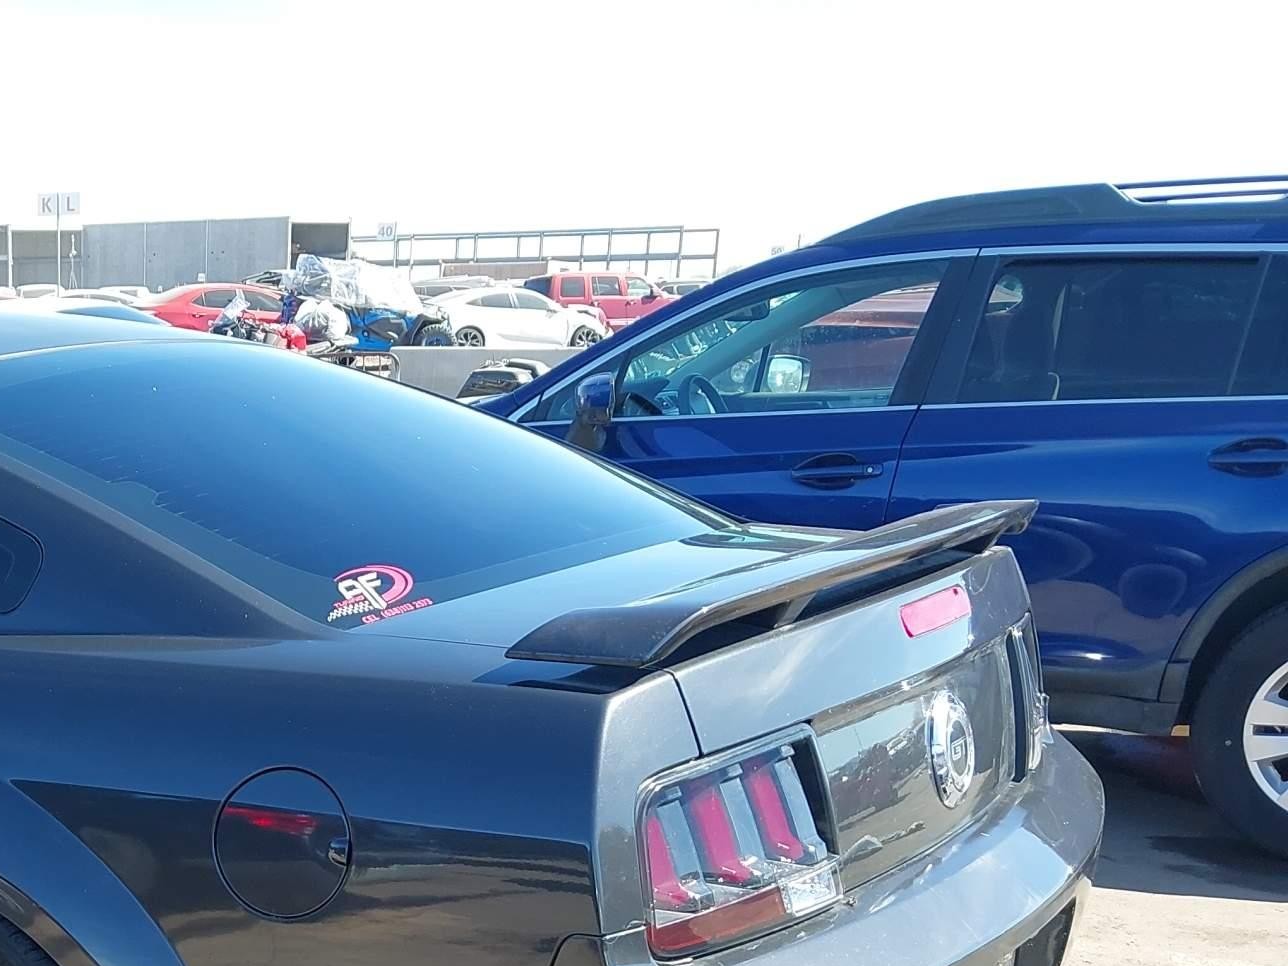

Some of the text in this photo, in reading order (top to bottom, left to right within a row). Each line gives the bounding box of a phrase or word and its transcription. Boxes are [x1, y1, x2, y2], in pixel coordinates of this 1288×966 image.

[41, 196, 76, 214] K L
[377, 225, 393, 238] 40
[952, 735, 967, 761] GT
